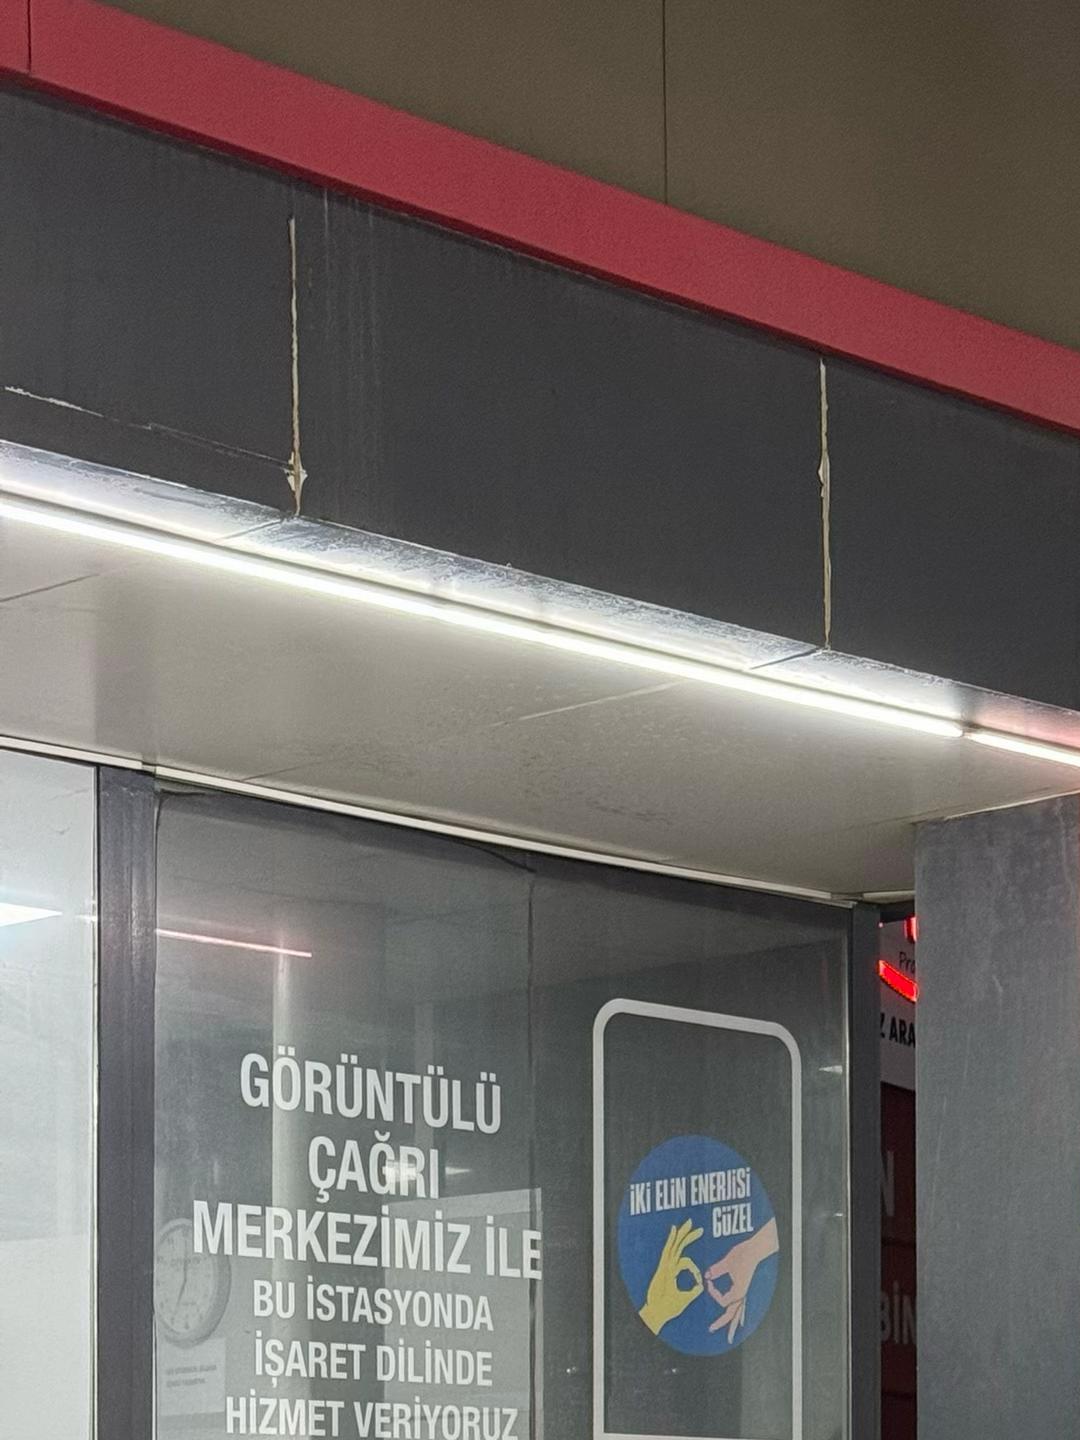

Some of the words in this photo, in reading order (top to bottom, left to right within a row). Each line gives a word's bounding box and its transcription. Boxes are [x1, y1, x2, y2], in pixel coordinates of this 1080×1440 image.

[240, 1045, 502, 1134] GÖRÜNTÜLÜ
[308, 1130, 440, 1204] ÇAĞRI
[192, 1199, 470, 1275] MERKEZİMİZ
[485, 1215, 543, 1281] İLE
[712, 1203, 754, 1238] GÜZEL
[253, 1279, 295, 1319] BU
[306, 1275, 494, 1332] İSTASYONDA
[254, 1330, 366, 1388] İŞARET
[375, 1338, 494, 1387] DİLİNDE
[225, 1389, 344, 1439] HİZMET
